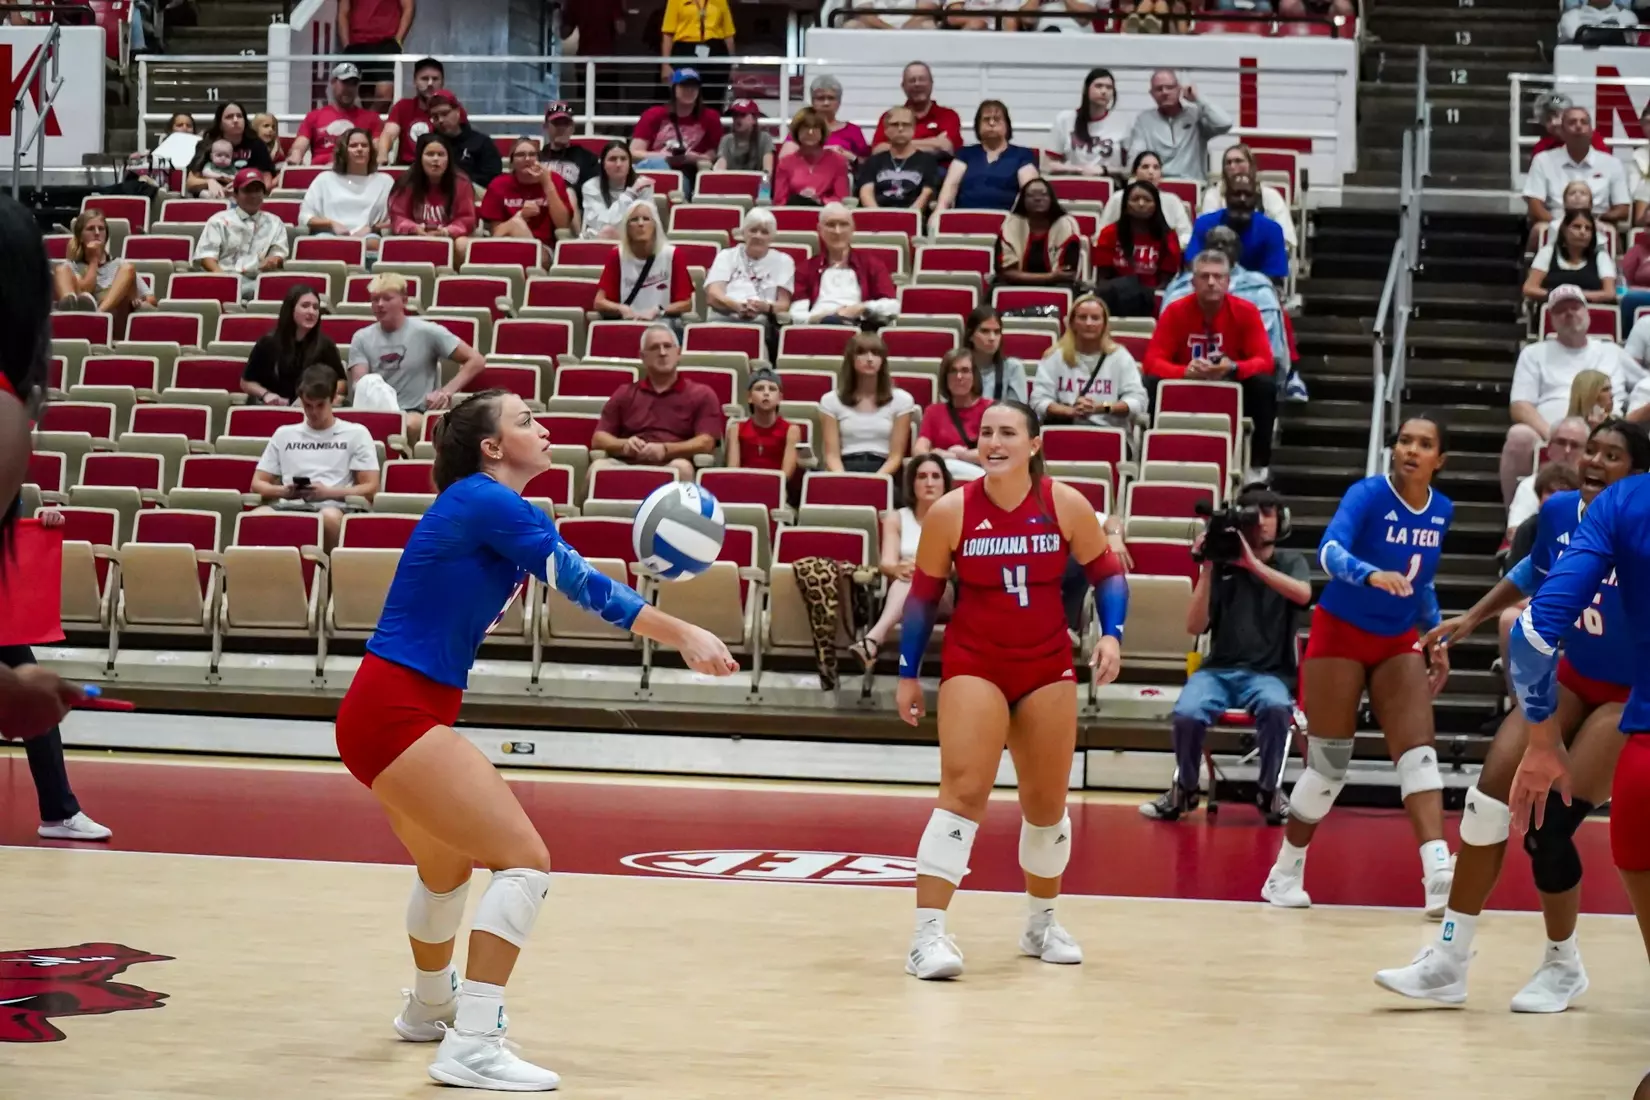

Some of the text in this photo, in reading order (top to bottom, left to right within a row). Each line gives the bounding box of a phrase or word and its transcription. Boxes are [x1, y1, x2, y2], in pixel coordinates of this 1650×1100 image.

[1455, 31, 1472, 46] 13
[1450, 69, 1469, 84] 12
[206, 87, 219, 101] 11
[1446, 108, 1460, 123] 11
[1057, 376, 1073, 392] LA
[285, 442, 348, 450] ARKANSAS
[1385, 525, 1440, 548] LA TECH
[962, 533, 1060, 557] LOUISIANA TECH
[1001, 564, 1030, 608] 4
